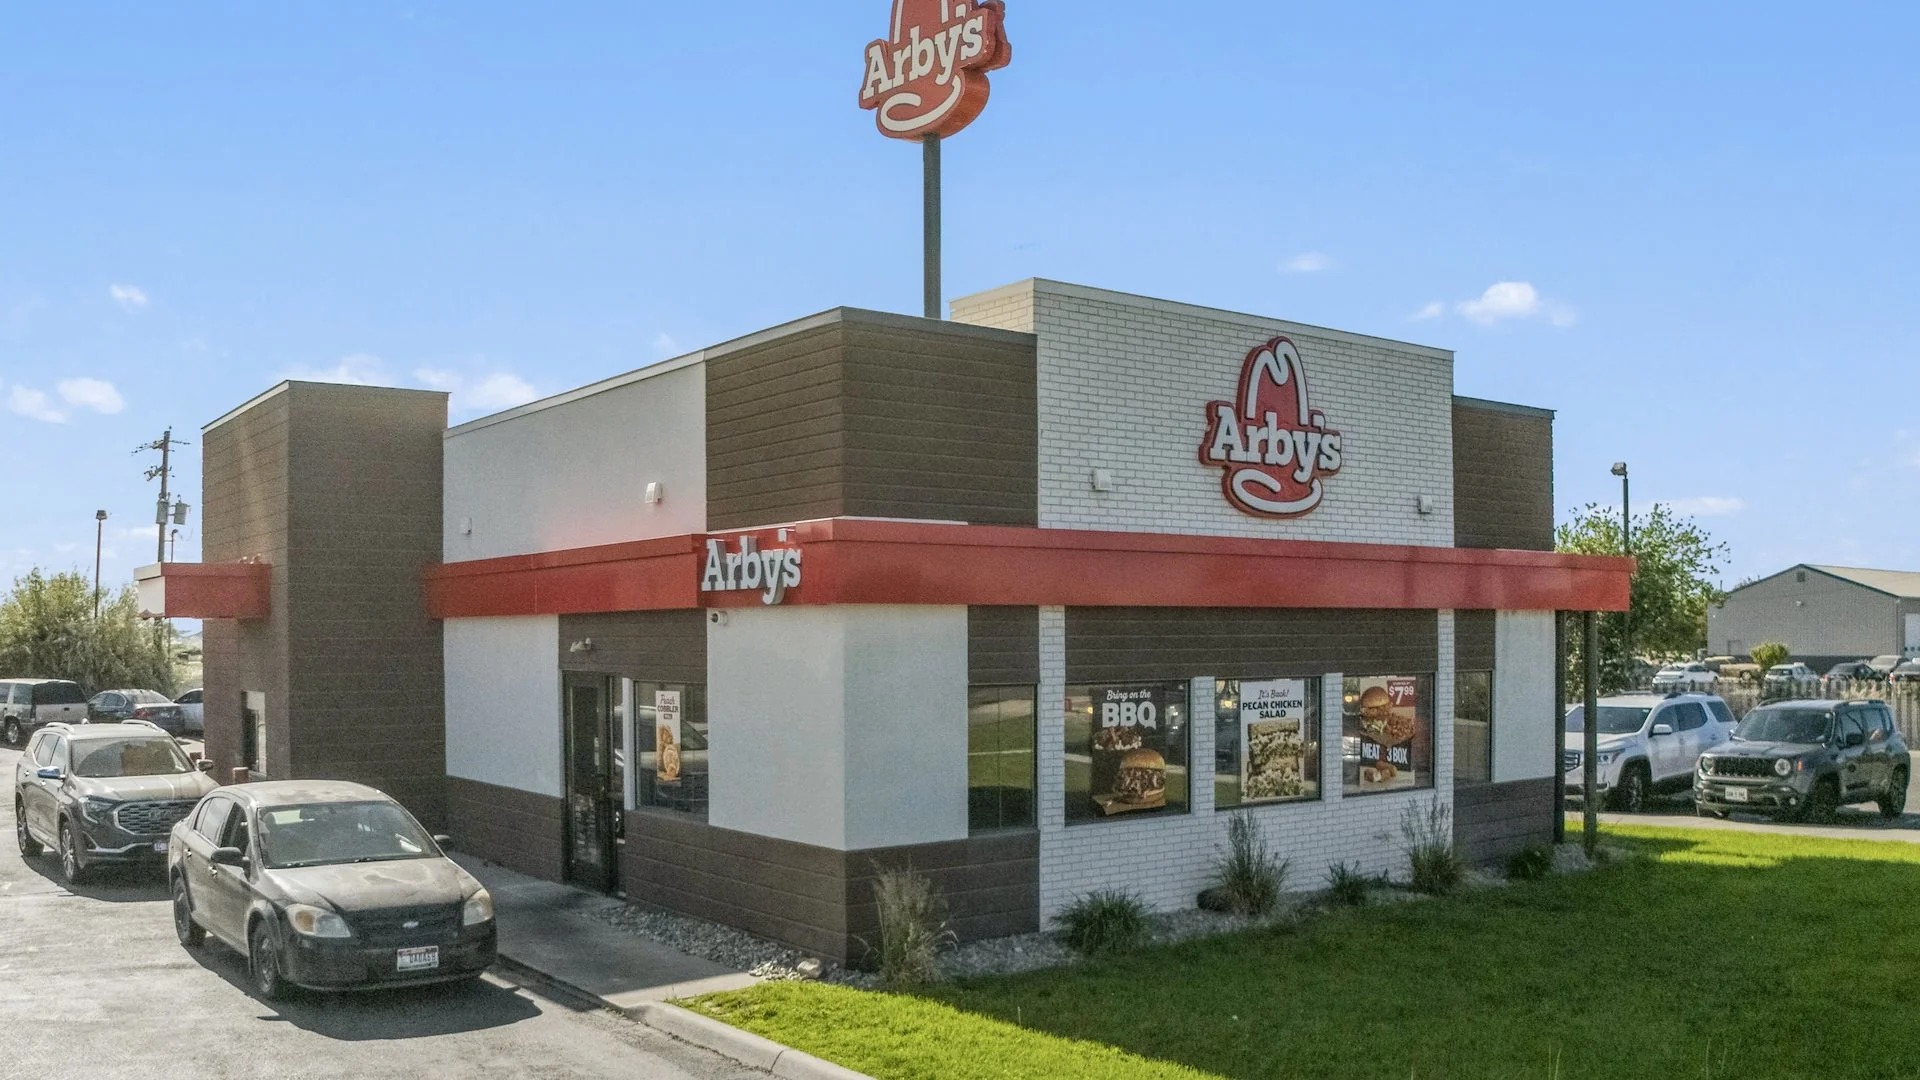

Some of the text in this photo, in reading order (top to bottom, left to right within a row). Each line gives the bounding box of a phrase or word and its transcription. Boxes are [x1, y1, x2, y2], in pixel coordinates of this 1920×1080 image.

[863, 4, 983, 100] Arby's
[1210, 406, 1341, 483] Arby's
[701, 528, 801, 605] Arby's
[1106, 689, 1151, 702] Bring on the
[1242, 699, 1303, 711] PECAN CHICKEN
[1258, 689, 1289, 699] It's Back!
[1102, 701, 1157, 730] BBQ
[1259, 709, 1287, 719] SALAD
[1362, 742, 1408, 765] MEAT 3 BOX
